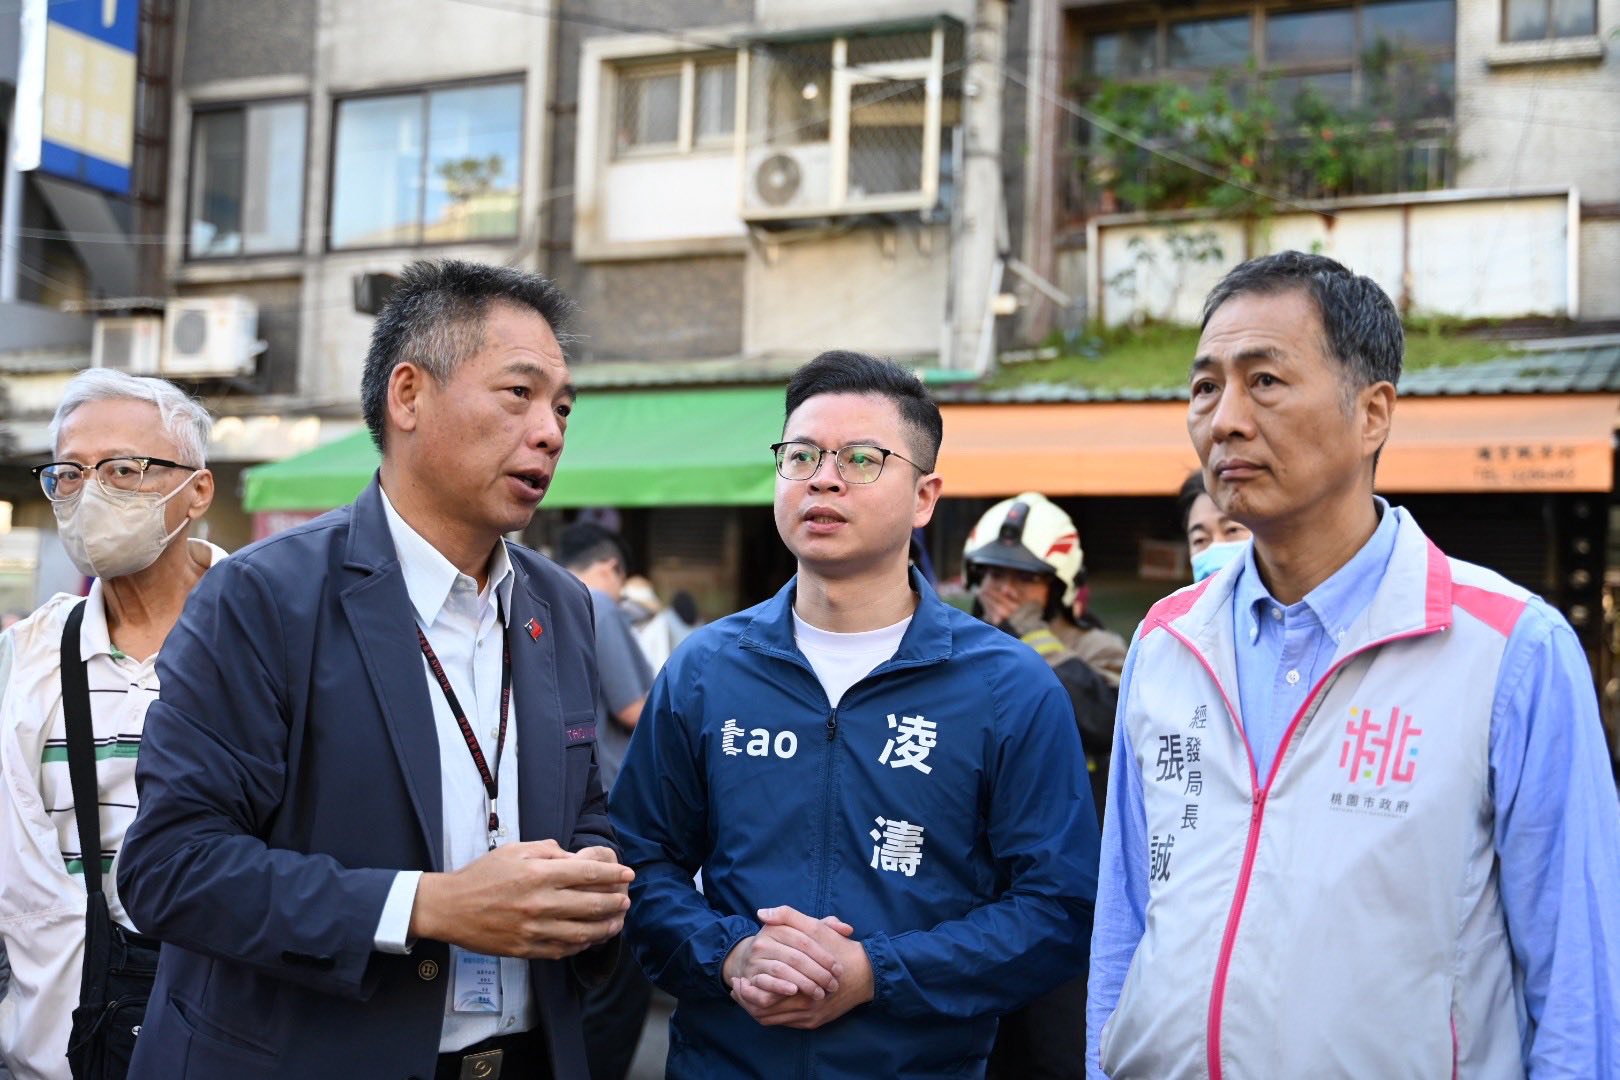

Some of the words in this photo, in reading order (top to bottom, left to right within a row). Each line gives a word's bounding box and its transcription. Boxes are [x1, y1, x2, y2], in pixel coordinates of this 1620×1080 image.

[720, 718, 798, 759] tao
[869, 713, 938, 877] 凌濤
[1180, 704, 1208, 830] 經發局長
[1149, 734, 1184, 883] 張誠
[1330, 793, 1410, 814] 桃園市政府
